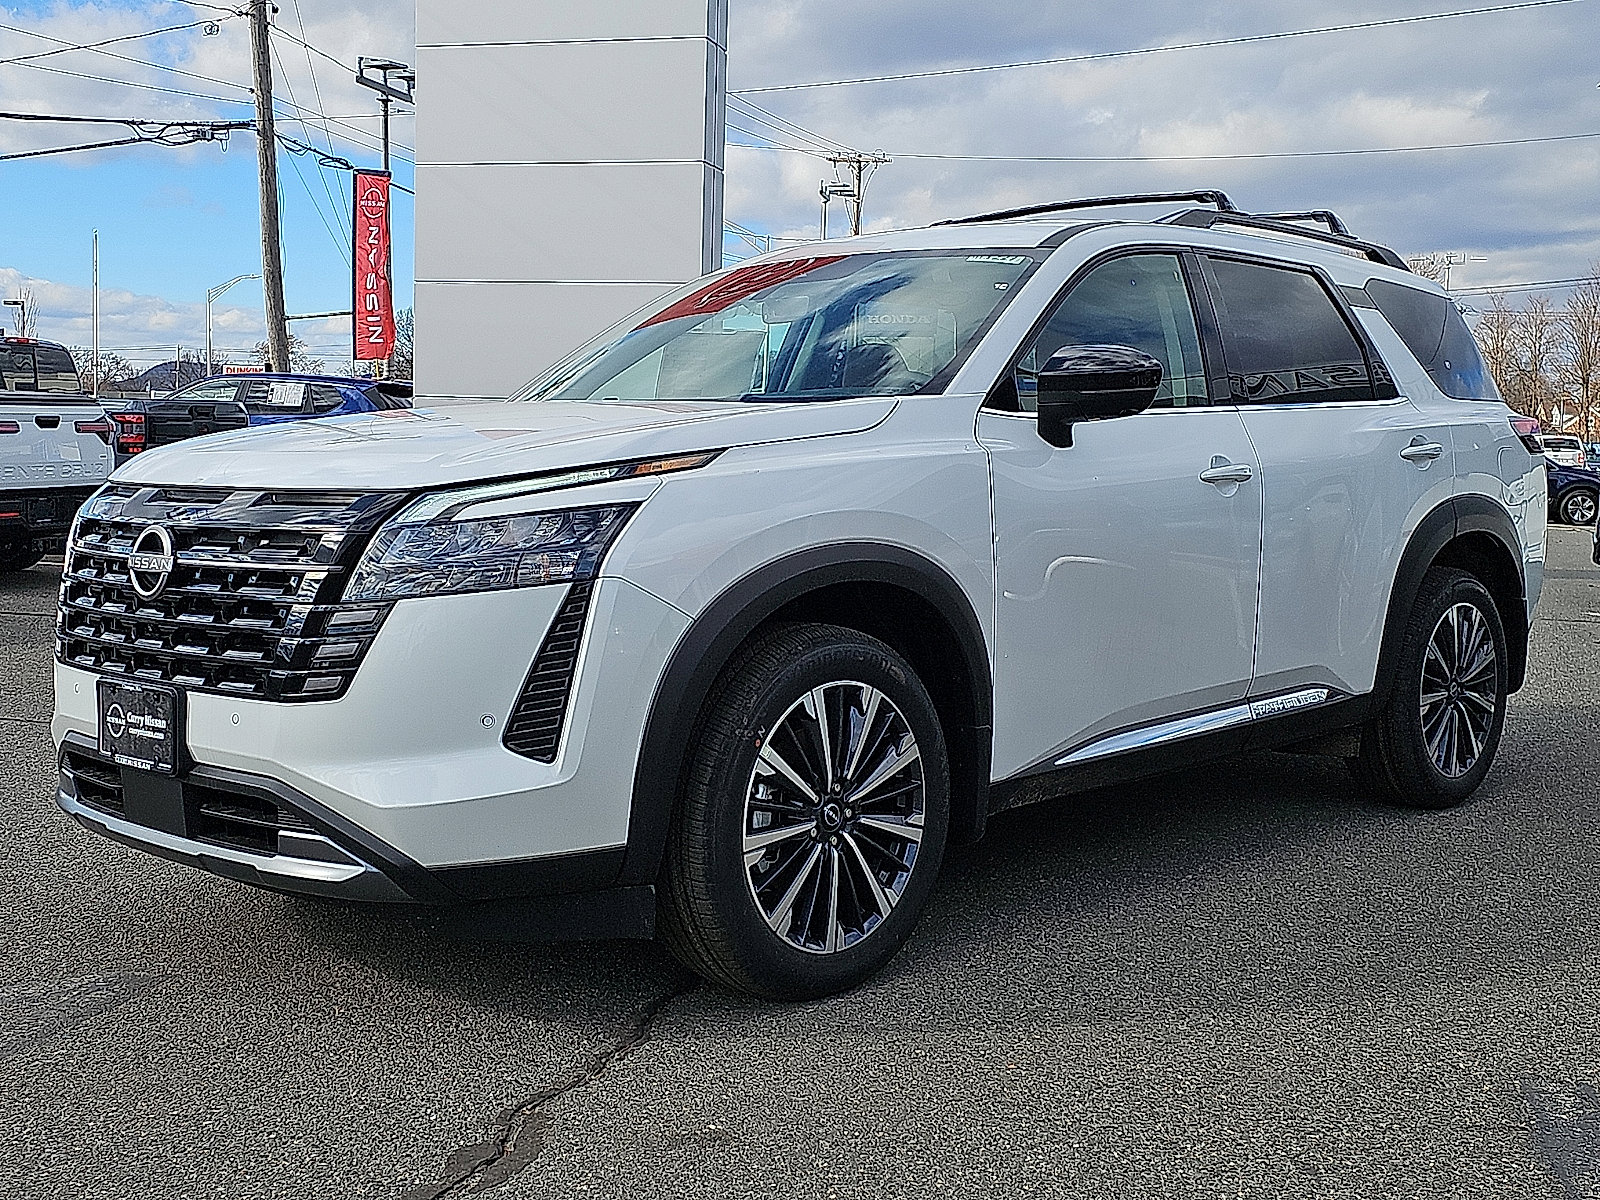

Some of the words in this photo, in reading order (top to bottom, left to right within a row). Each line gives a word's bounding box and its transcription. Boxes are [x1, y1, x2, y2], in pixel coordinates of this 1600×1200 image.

[359, 200, 385, 208] NISSAN
[366, 226, 384, 344] NISSAN
[867, 314, 931, 324] HONDA
[0, 463, 56, 480] ANTA
[127, 711, 144, 727] Curry
[145, 714, 166, 728] Nissan
